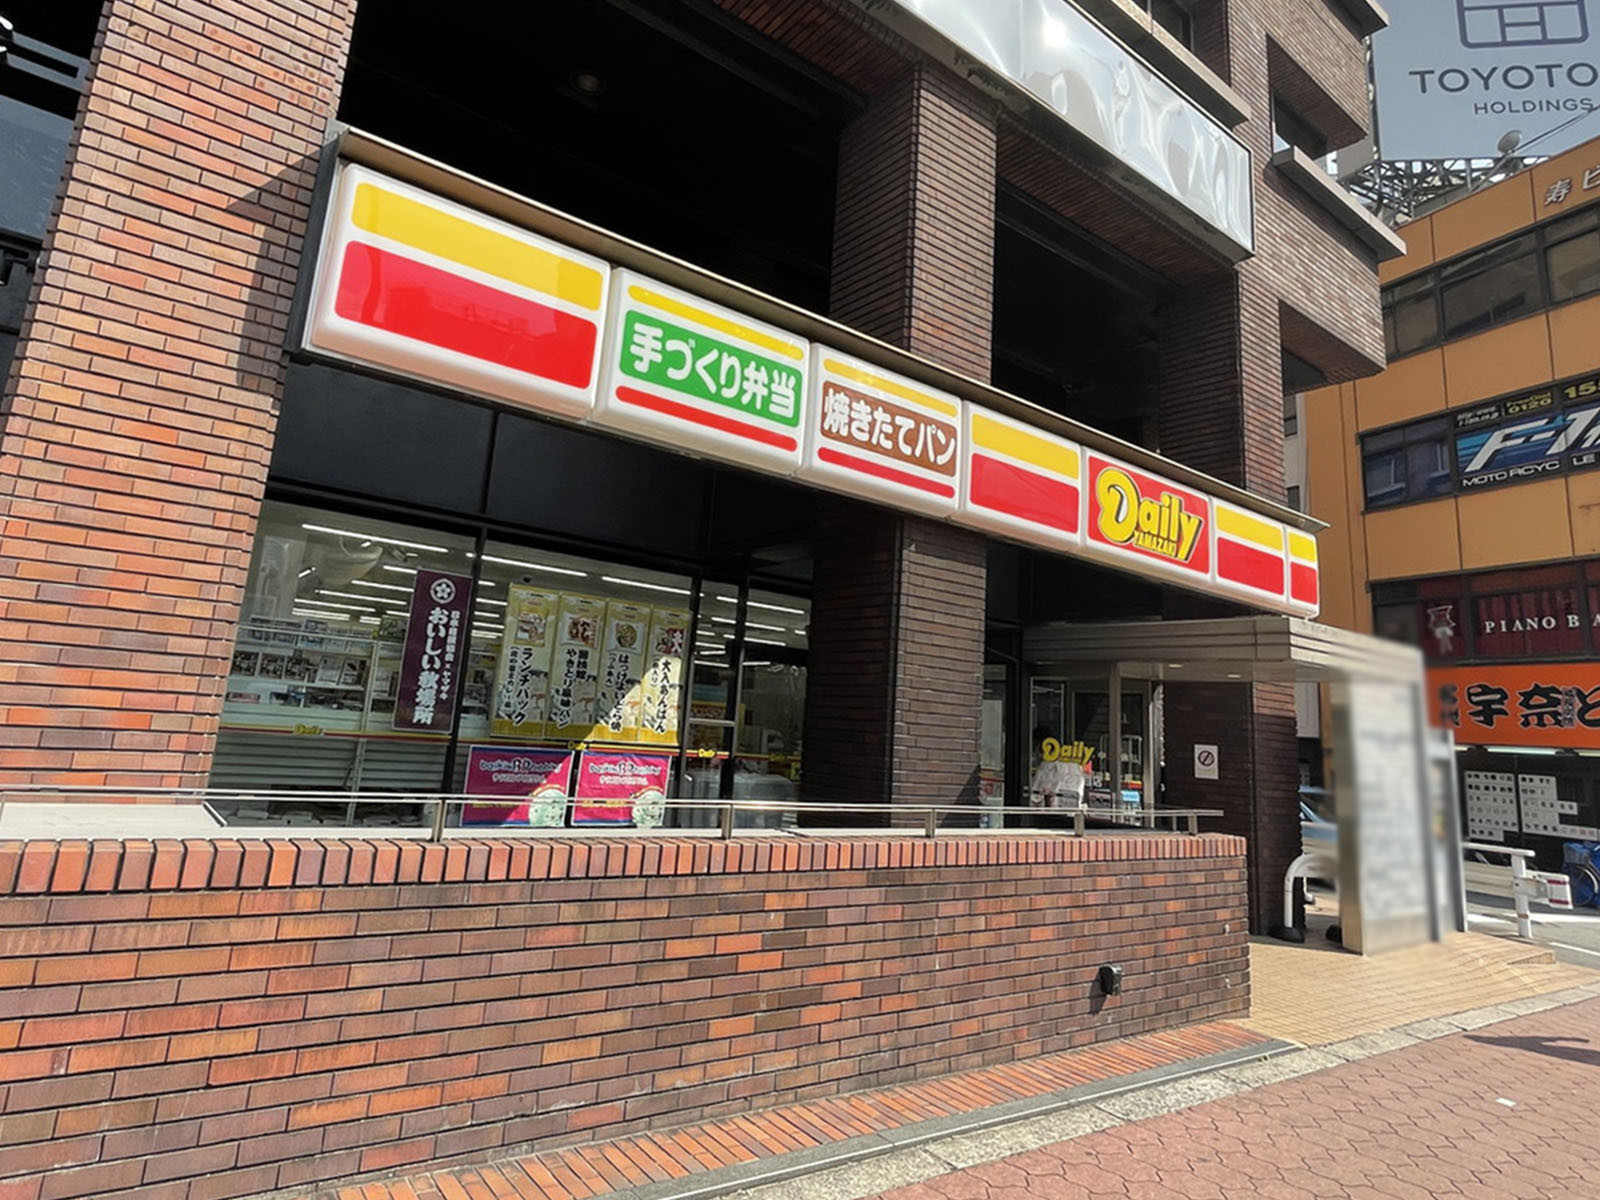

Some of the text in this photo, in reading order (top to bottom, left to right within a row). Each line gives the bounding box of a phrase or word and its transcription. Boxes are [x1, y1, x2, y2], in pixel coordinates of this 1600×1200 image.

[1408, 61, 1600, 94] TOYOTO
[1474, 97, 1594, 115] HOLDINGS
[629, 322, 797, 419] 手づくり弁当
[823, 388, 957, 466] 焼きたてパン
[1508, 397, 1552, 414] 0120
[1096, 467, 1204, 563] Daily
[1484, 616, 1556, 633] PIANO
[412, 607, 449, 725] おいしい秋場所
[513, 647, 534, 726] ランチパック
[1042, 737, 1095, 766] Daily
